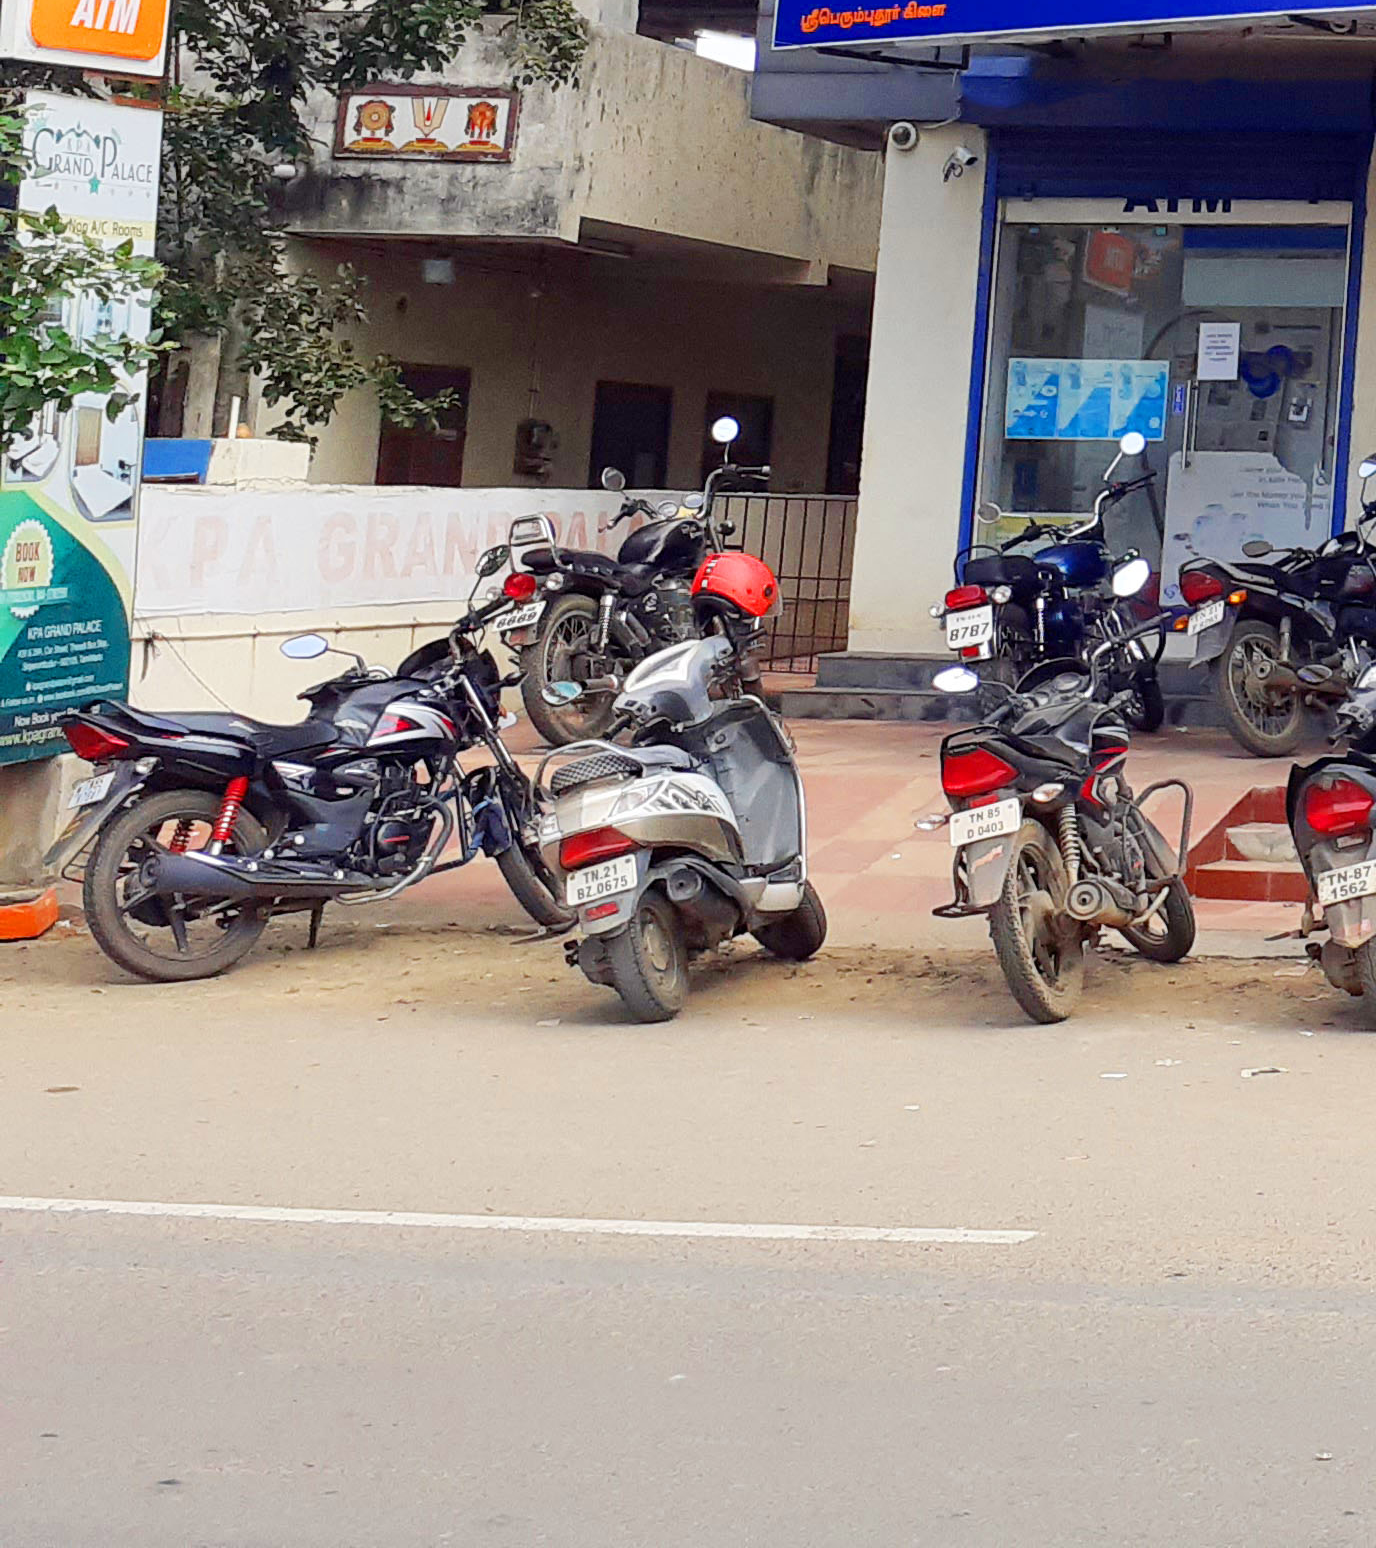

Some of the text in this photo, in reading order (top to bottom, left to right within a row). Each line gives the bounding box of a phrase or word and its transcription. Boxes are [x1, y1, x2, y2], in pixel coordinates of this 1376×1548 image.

[101, 136, 154, 184] PALACE
[15, 540, 41, 563] BOOK
[950, 622, 990, 642] 8787
[969, 807, 1001, 824] TN 85
[977, 821, 1004, 836] 0403
[1326, 865, 1373, 887] TN-87
[1330, 880, 1369, 900] 1562
